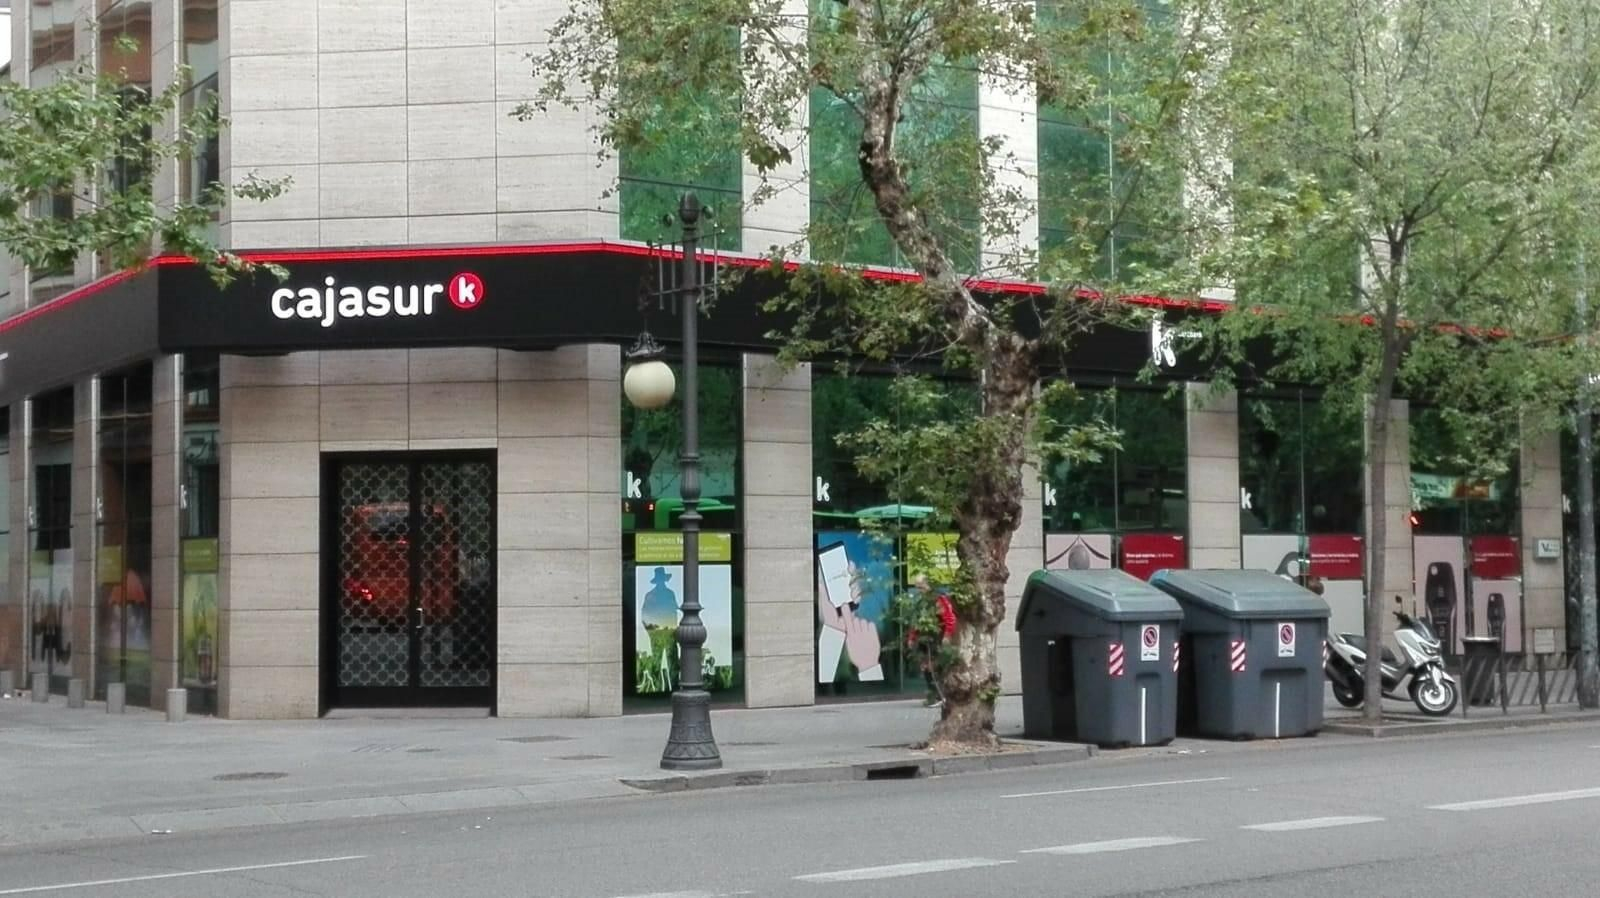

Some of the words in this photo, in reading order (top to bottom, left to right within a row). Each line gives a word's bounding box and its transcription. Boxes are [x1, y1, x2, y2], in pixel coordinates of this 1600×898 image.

[271, 276, 444, 328] cajasur
[626, 471, 642, 499] k
[816, 475, 830, 502] k
[1044, 482, 1057, 507] k
[1241, 487, 1252, 510] k
